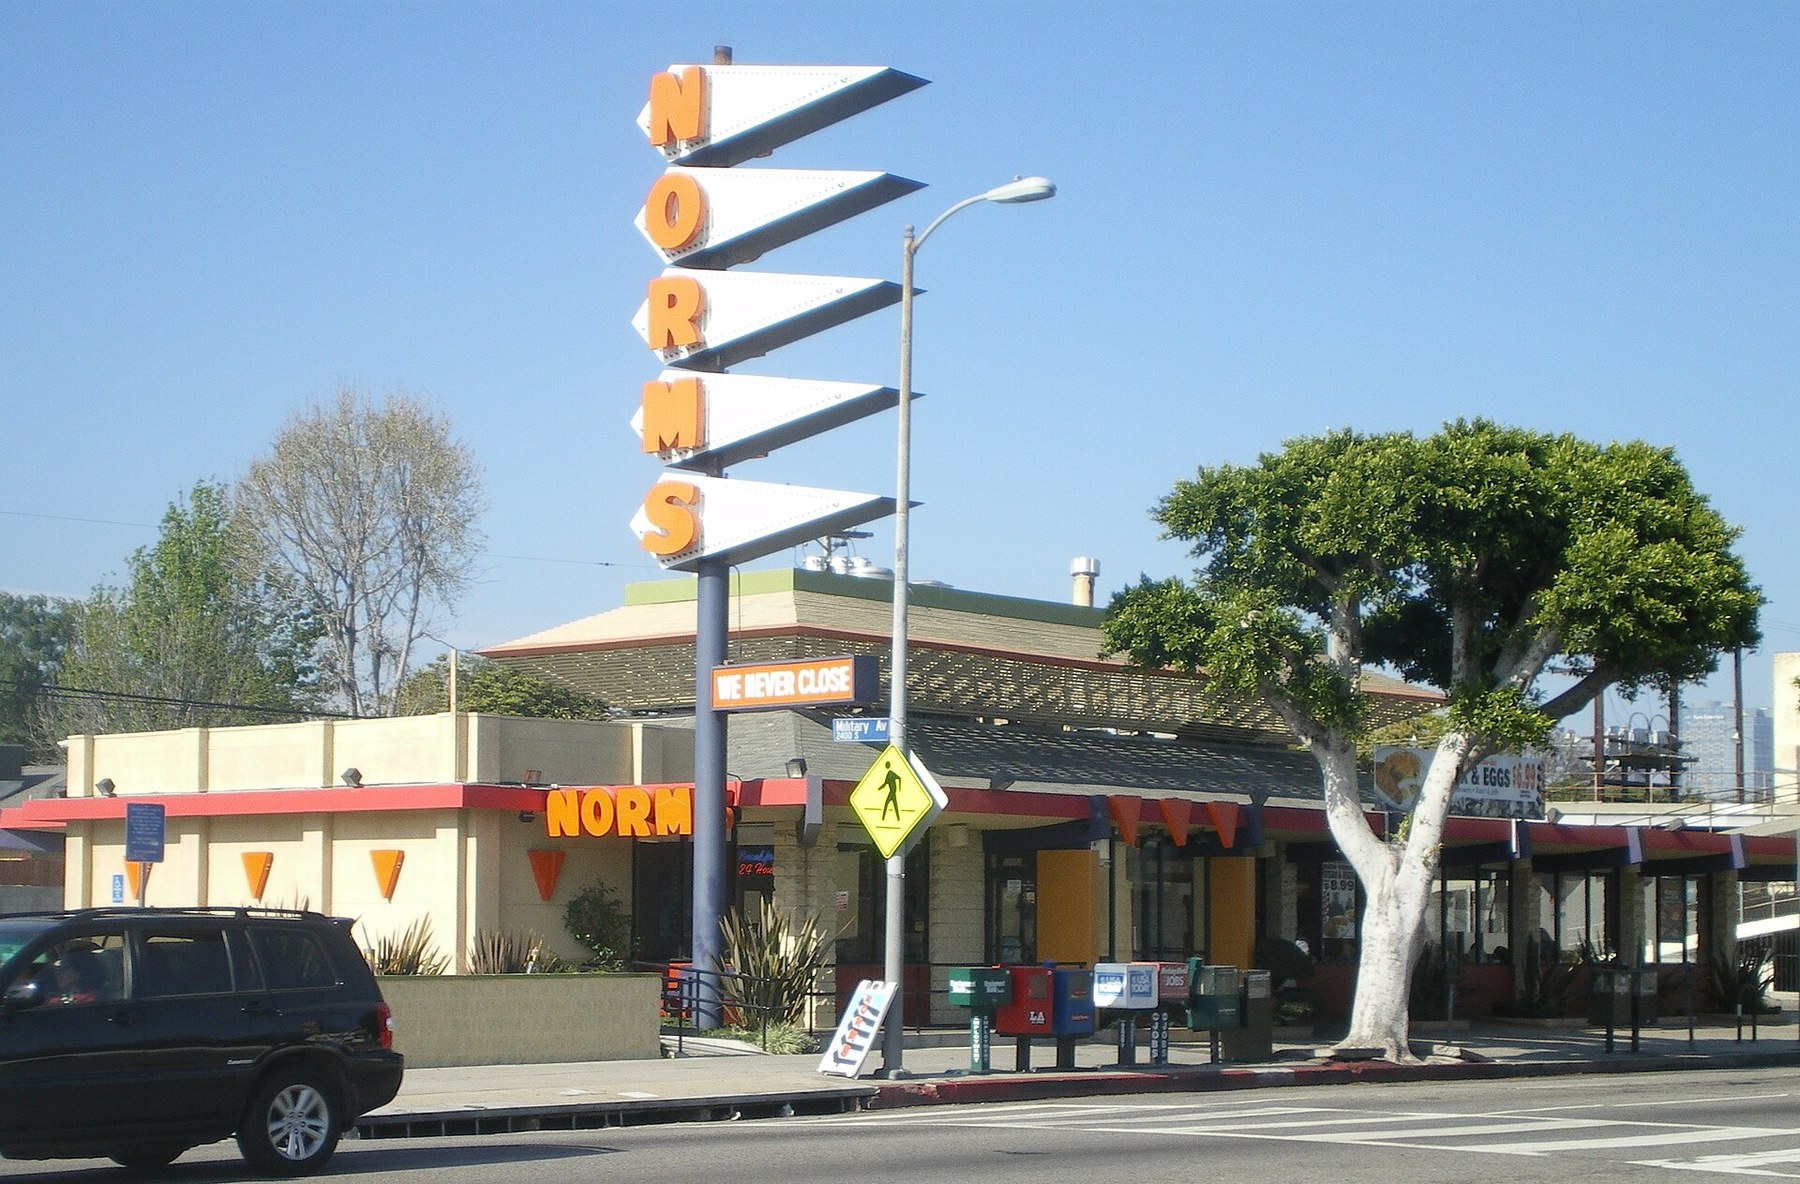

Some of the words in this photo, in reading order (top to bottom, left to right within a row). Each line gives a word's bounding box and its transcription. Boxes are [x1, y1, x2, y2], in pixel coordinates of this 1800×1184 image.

[641, 65, 708, 556] NORMS
[717, 674, 741, 700] WE
[744, 670, 795, 698] NEVER
[798, 665, 850, 695] CLOSE
[836, 720, 870, 734] Military
[875, 720, 887, 731] Av
[836, 732, 852, 740] 2400
[854, 732, 859, 740] S
[1483, 766, 1510, 788] EGGS
[546, 787, 735, 838] NORM
[739, 863, 753, 875] 24
[1137, 975, 1150, 984] USA
[1165, 976, 1184, 986] JOBS
[1131, 984, 1150, 993] TODAY
[1029, 1011, 1045, 1021] LA
